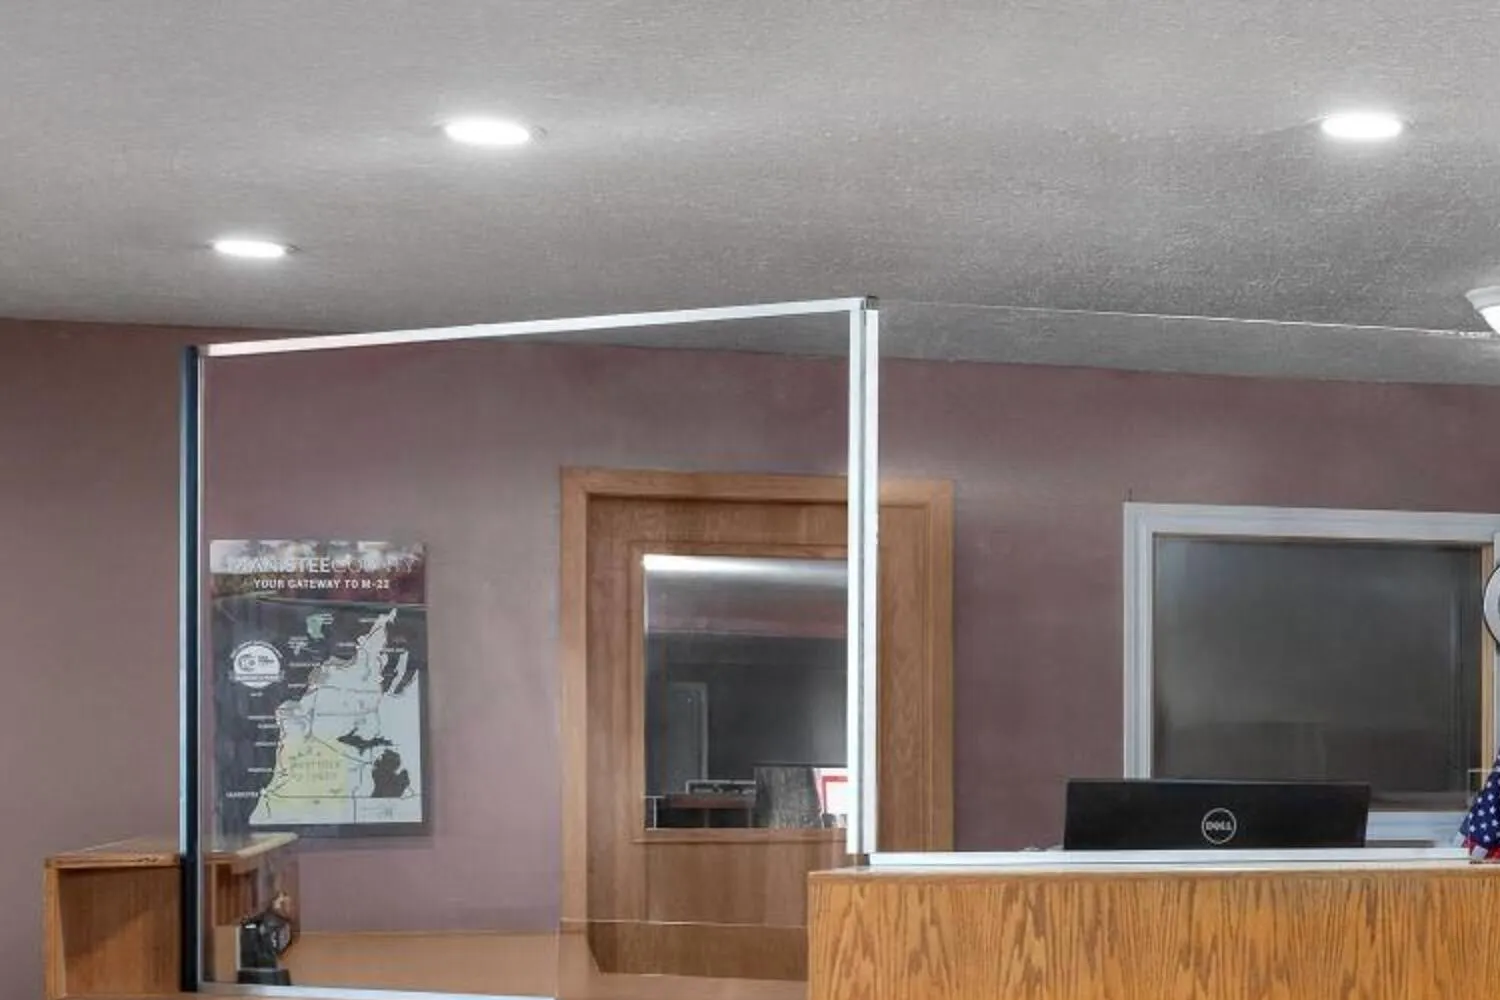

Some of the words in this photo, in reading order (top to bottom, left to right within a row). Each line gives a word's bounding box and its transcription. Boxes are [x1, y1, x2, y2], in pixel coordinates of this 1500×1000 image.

[253, 579, 285, 589] YOUR
[287, 579, 341, 589] GATEWAY
[345, 579, 359, 589] TO
[1205, 820, 1232, 831] DELL
